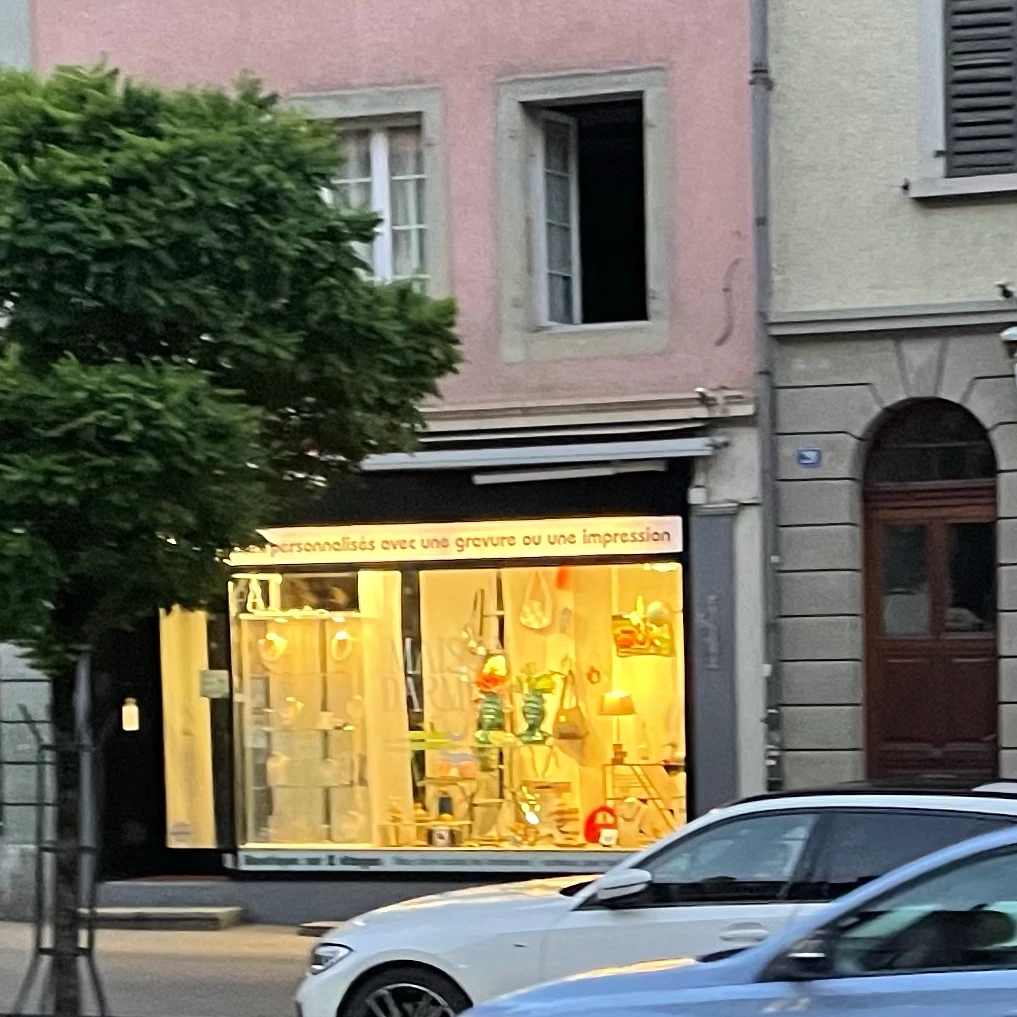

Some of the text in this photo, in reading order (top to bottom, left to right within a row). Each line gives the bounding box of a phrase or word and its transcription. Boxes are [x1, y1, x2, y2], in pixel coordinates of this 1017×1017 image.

[381, 537, 417, 550] avec
[421, 535, 450, 550] une
[455, 534, 516, 552] gravure
[523, 535, 542, 546] ou
[548, 534, 577, 546] une
[582, 527, 671, 548] impression
